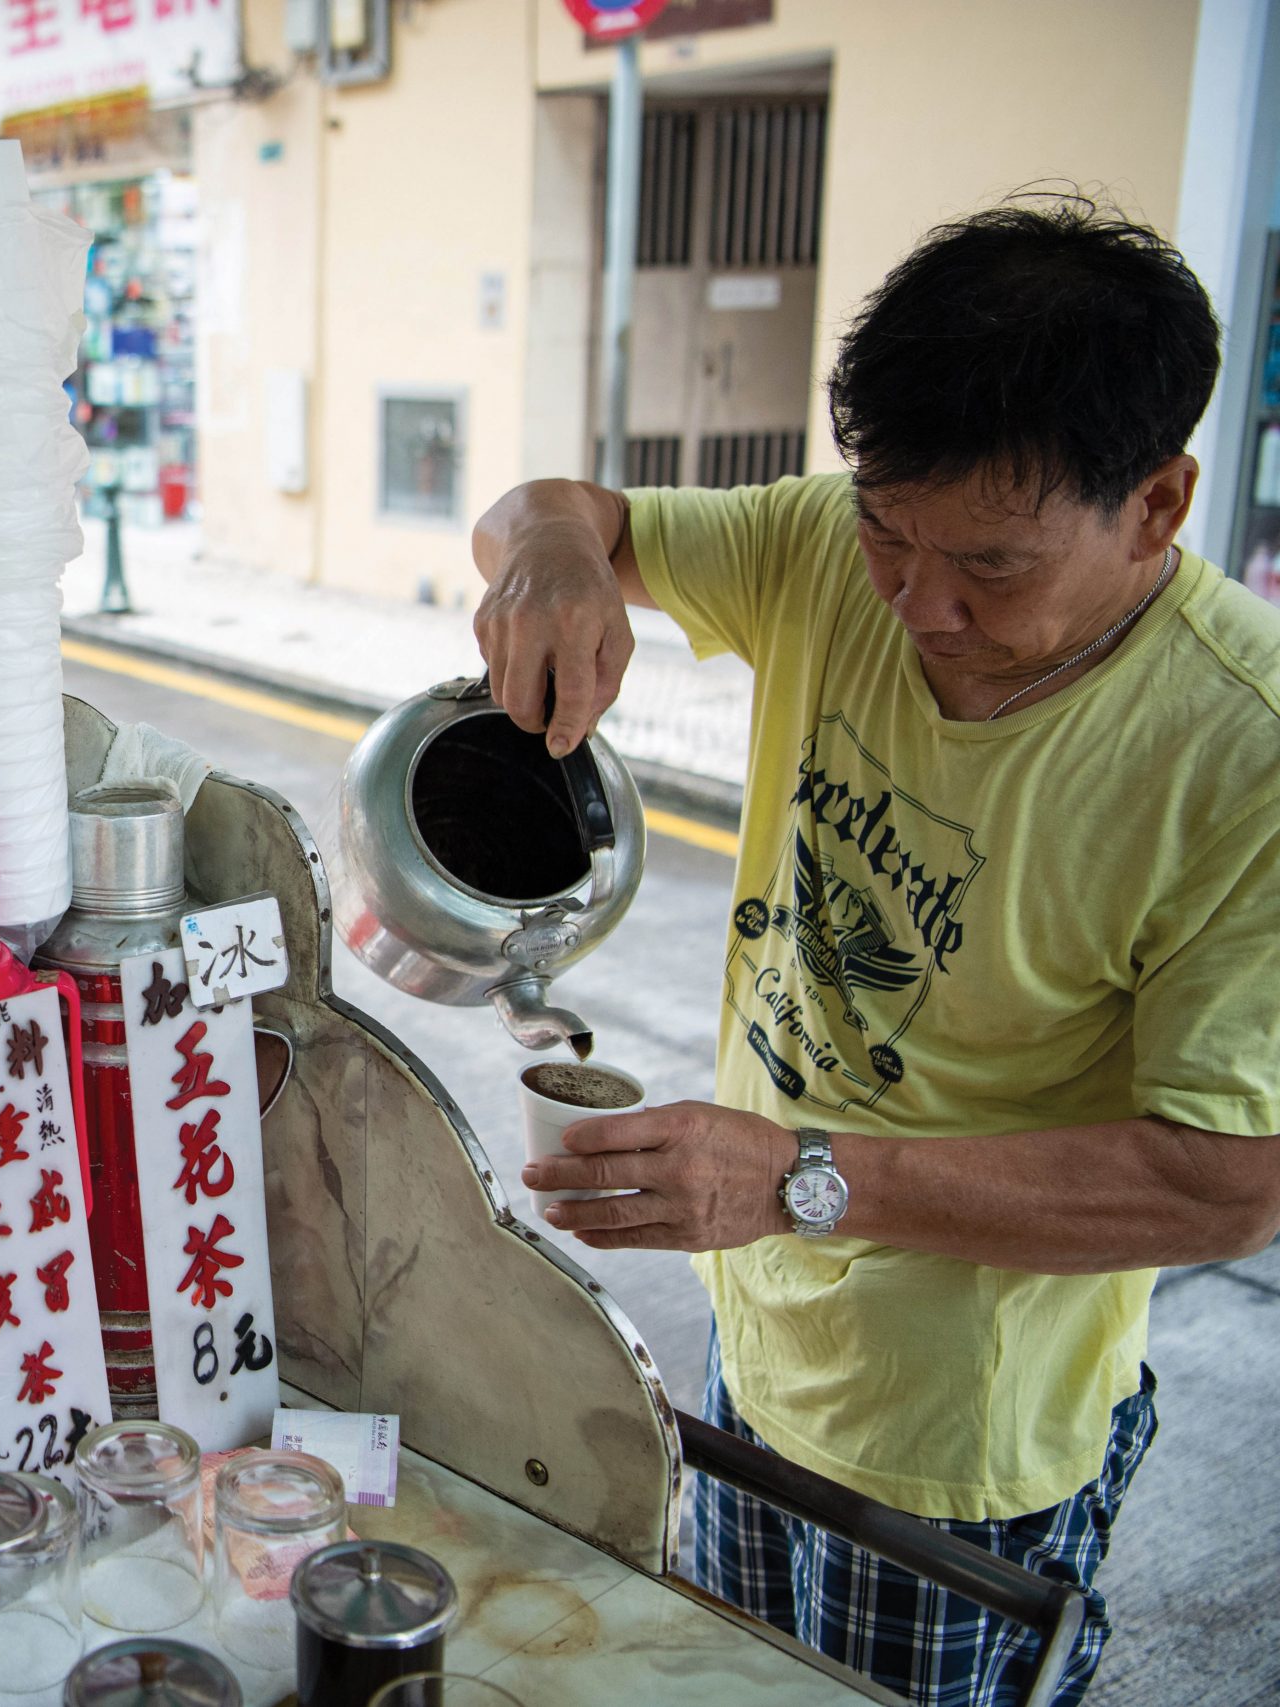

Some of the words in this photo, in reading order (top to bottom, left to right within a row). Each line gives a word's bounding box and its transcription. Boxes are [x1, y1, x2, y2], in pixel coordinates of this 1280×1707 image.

[198, 923, 280, 985] 冰
[755, 967, 839, 1073] California
[166, 1021, 244, 1310] 五花茶
[17, 1340, 64, 1404] 茶
[191, 1312, 274, 1386] 8元
